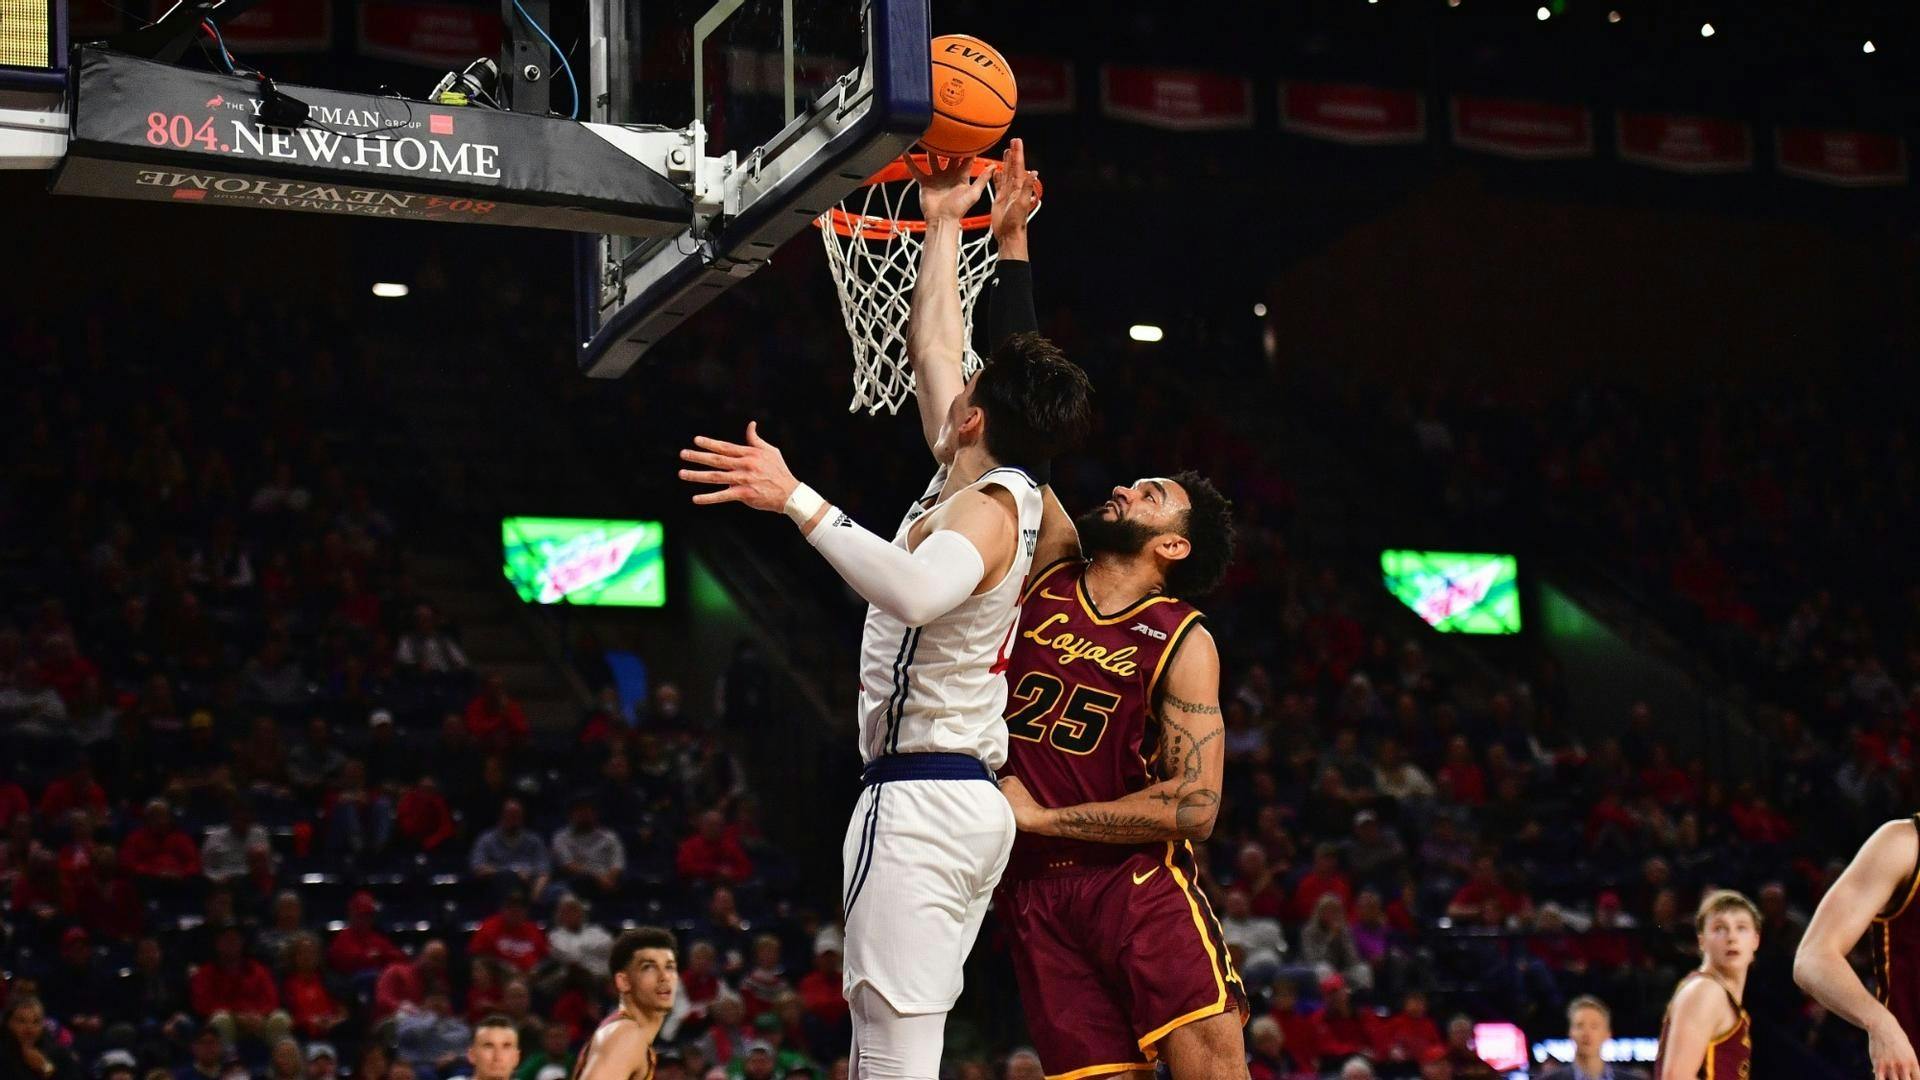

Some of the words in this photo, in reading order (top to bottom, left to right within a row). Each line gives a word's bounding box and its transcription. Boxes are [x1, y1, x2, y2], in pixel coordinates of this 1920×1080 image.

[945, 43, 993, 67] EVO
[226, 102, 244, 111] THE
[249, 98, 380, 128] YTMAN
[384, 119, 422, 129] GROUP
[146, 112, 500, 179] 804.NEW.HOME
[259, 197, 397, 215] YEATMAN
[1023, 613, 1138, 677] Loyola
[1130, 622, 1168, 641] A10
[1005, 671, 1122, 755] 25
